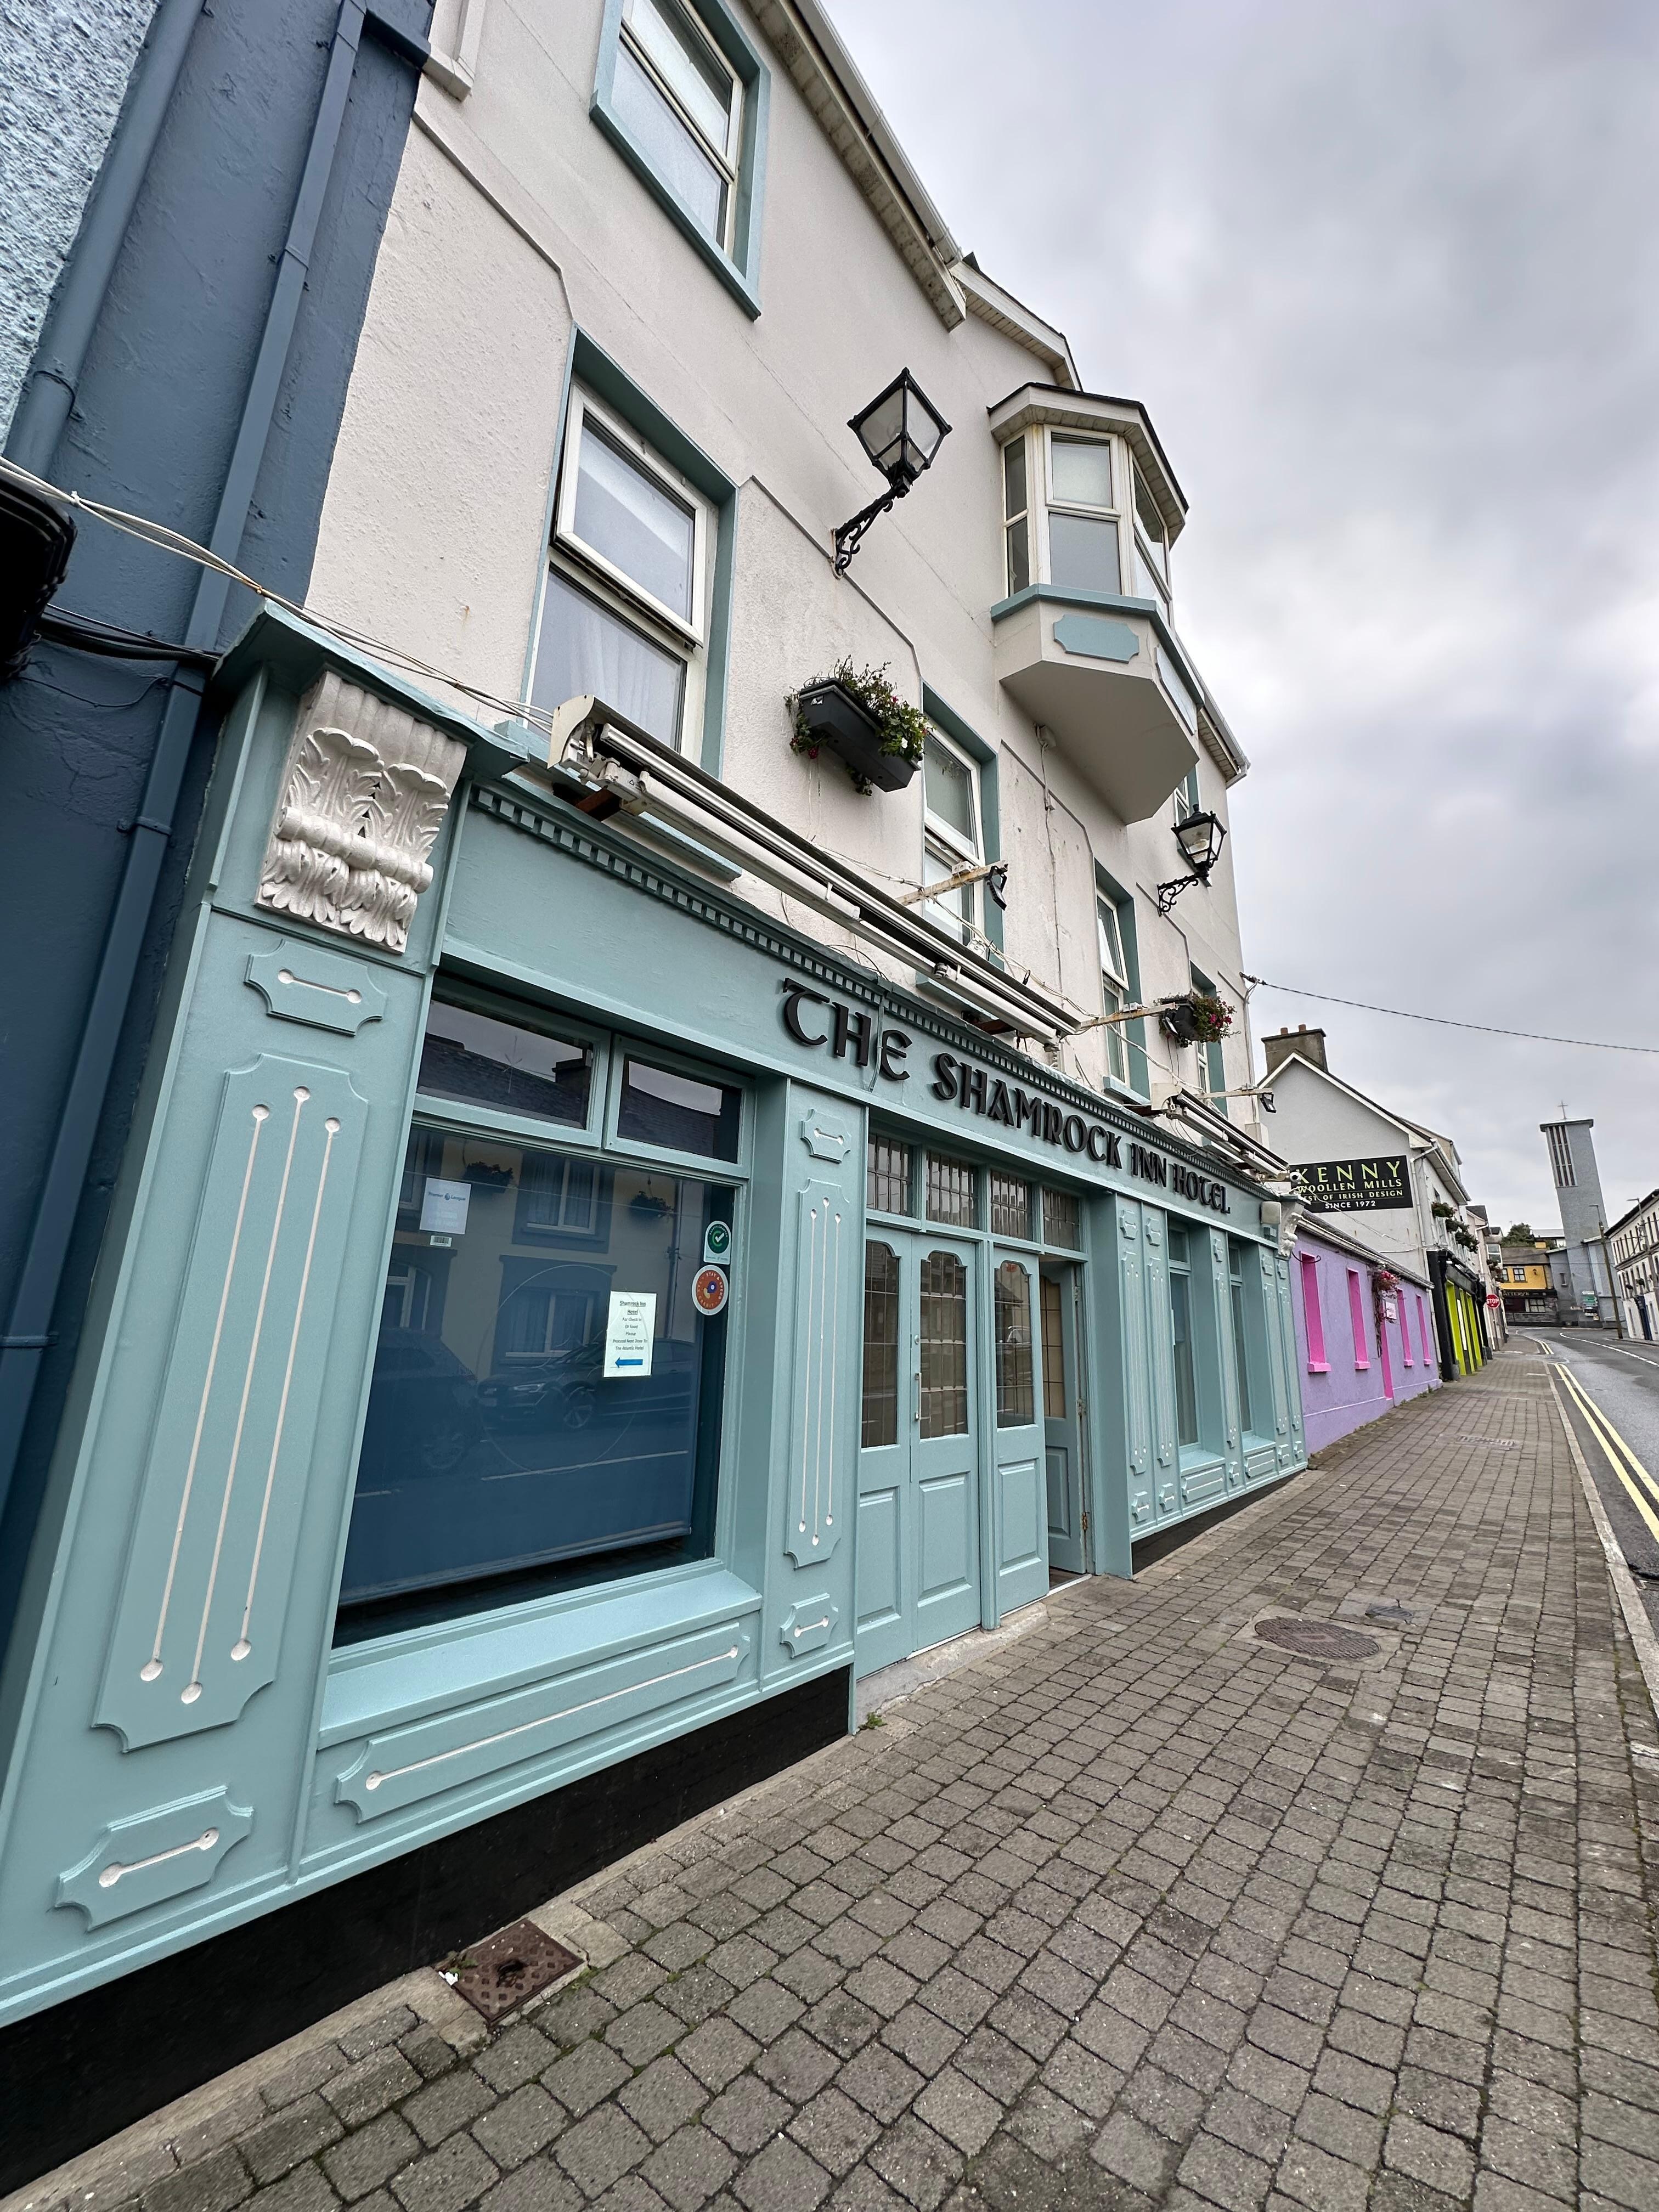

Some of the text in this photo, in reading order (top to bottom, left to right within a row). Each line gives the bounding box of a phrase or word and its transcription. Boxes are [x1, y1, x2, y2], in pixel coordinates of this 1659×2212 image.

[783, 978, 1231, 1214] THE SHAMROCK INN HOTEL
[1295, 1161, 1400, 1184] KENNY
[1297, 1179, 1402, 1193] WOOLLEN MILLS
